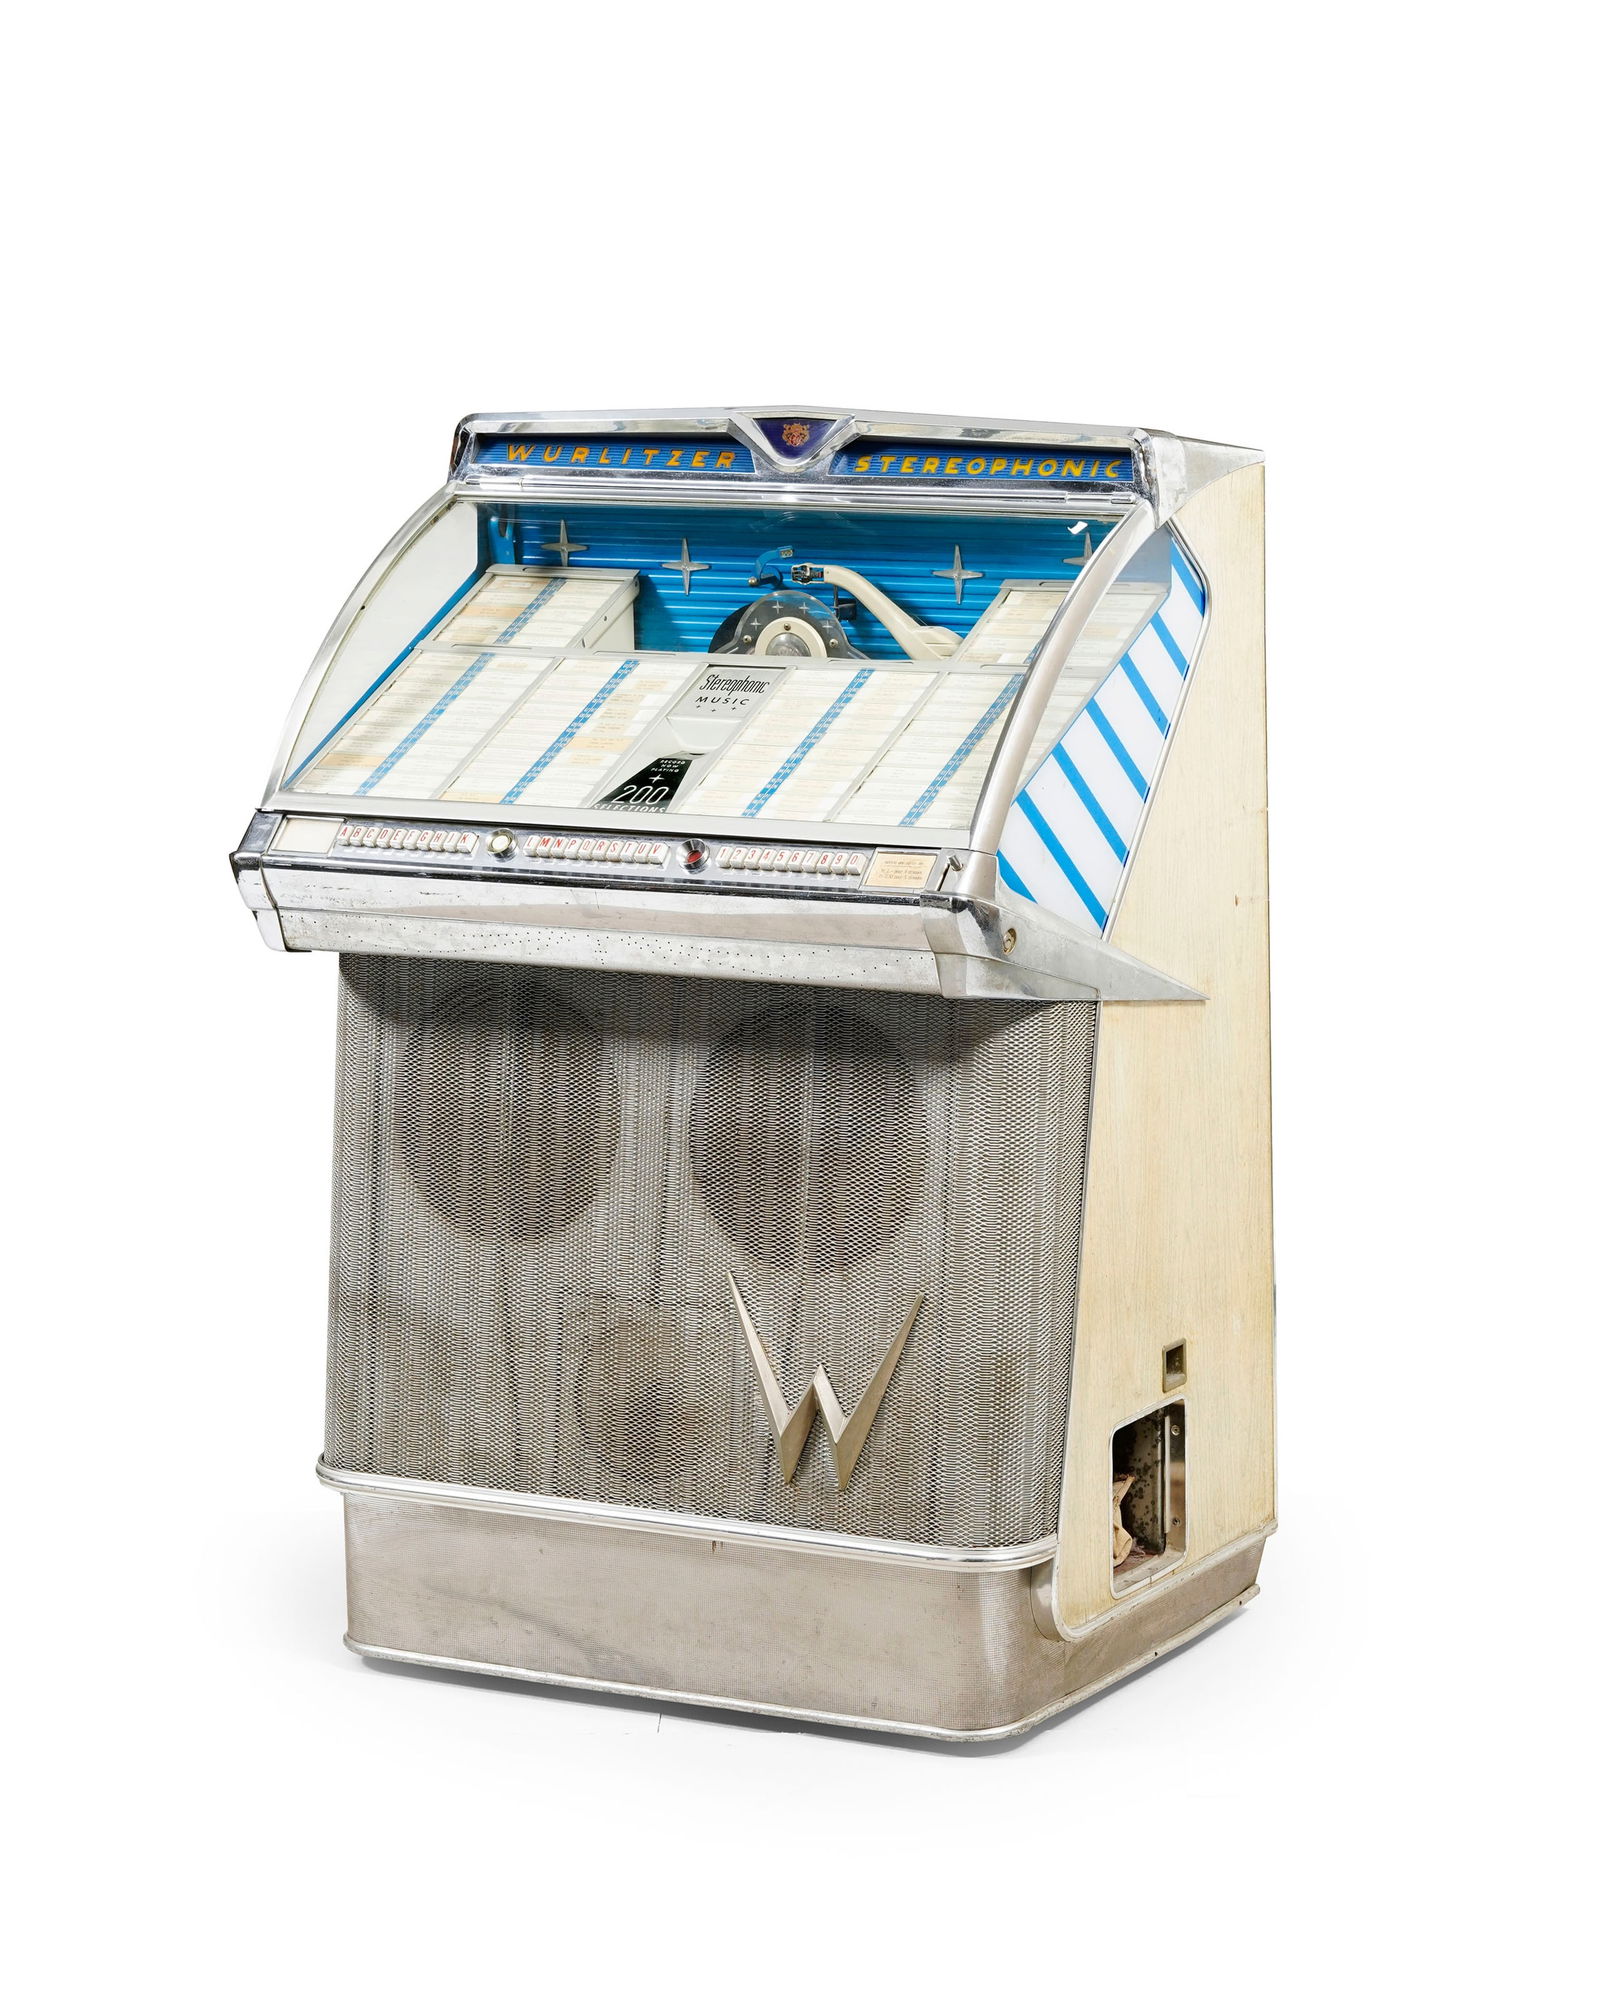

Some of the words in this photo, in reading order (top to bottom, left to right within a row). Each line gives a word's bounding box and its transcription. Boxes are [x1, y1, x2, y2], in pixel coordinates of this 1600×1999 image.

[507, 444, 736, 469] WURLITZER
[854, 455, 1122, 479] STEREOPHONIC
[698, 674, 770, 696] Stereophonic
[695, 696, 751, 706] MUSIC
[610, 784, 670, 805] 200
[593, 803, 666, 814] SELECTIONS
[726, 1269, 925, 1491] W
